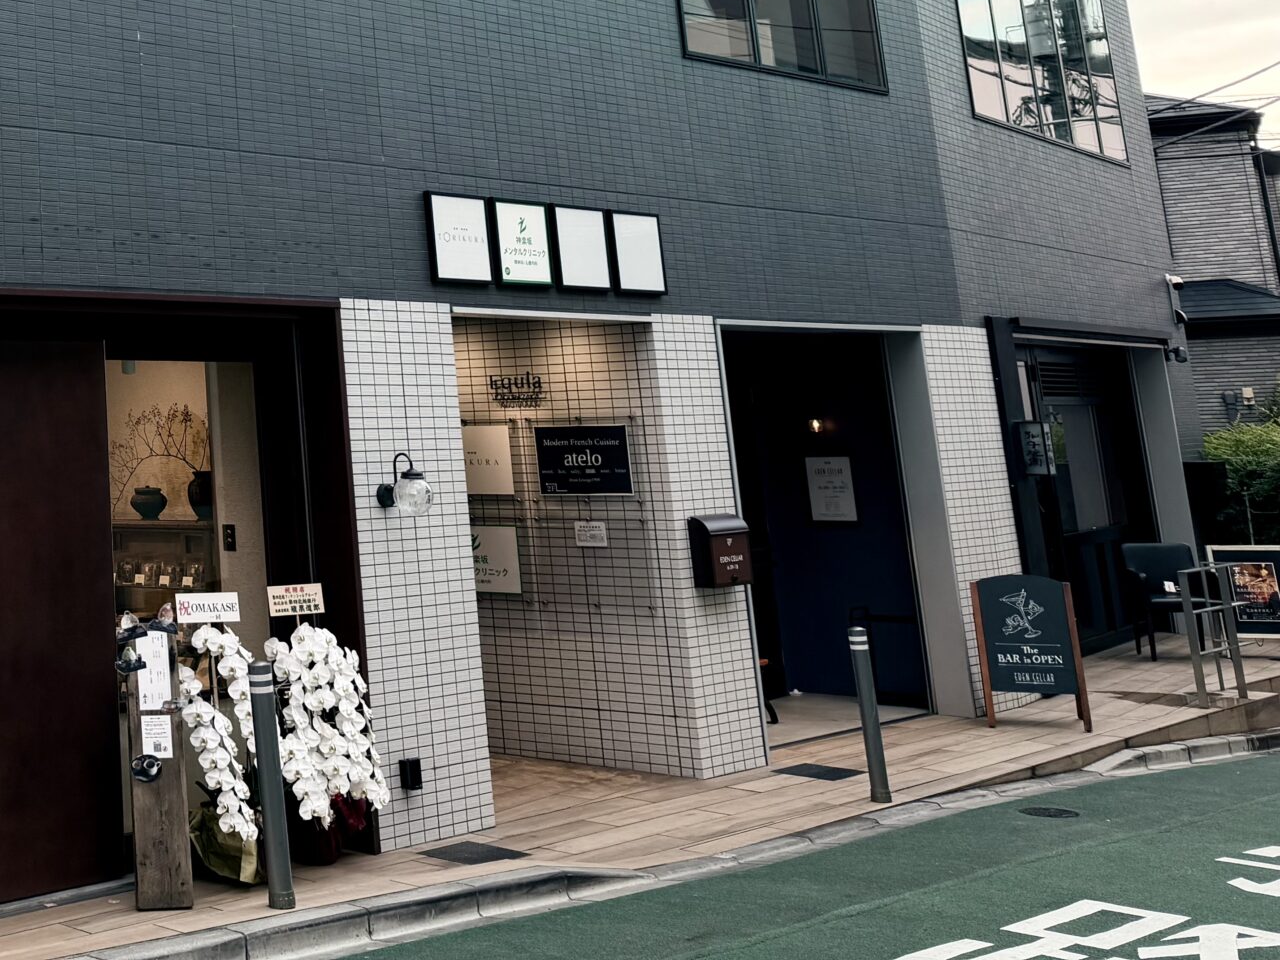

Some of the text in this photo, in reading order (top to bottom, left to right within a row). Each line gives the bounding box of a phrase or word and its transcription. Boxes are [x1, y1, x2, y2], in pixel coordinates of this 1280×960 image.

[503, 247, 546, 258] メンタルクリニック
[543, 437, 620, 447] Modern French Cuisine
[564, 449, 602, 467] atelo
[178, 599, 238, 616] 祝 OMAKASE
[1021, 646, 1039, 654] The
[997, 654, 1063, 664] BAR is OPEN
[1014, 672, 1055, 682] EDEN CELLAR
